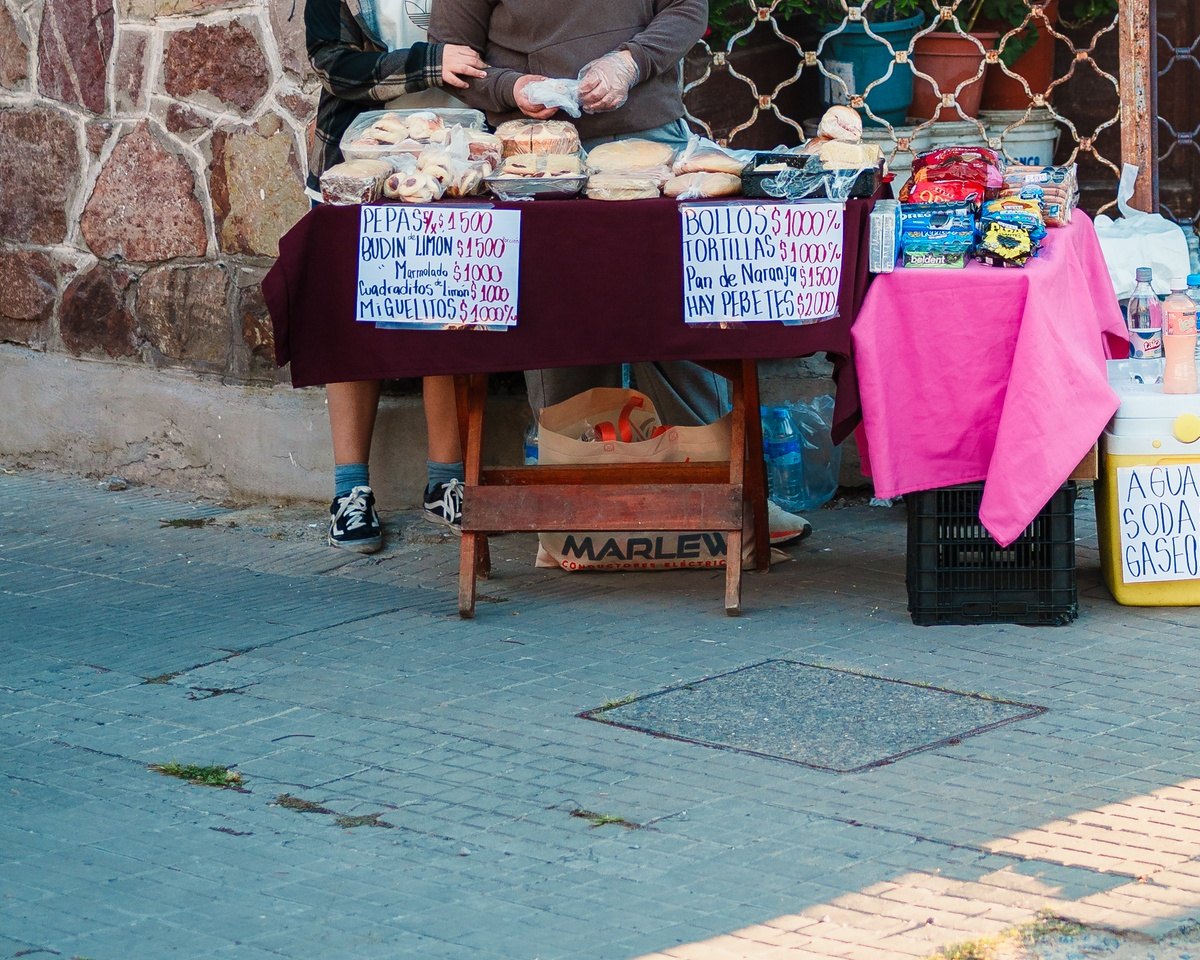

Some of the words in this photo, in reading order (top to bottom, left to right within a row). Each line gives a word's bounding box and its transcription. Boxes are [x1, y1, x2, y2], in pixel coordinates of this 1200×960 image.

[363, 207, 423, 234] PEPAS
[685, 205, 768, 236] BOLLOS
[361, 236, 406, 261] BUDIN
[456, 237, 506, 259] $1500
[683, 234, 775, 263] TORTILLAS
[453, 261, 503, 283] $1000
[686, 265, 713, 291] Pan
[719, 264, 738, 287] de
[741, 263, 797, 287] Naranja
[800, 266, 839, 289] $1500
[358, 279, 434, 297] Cuadraditos
[470, 281, 510, 303] $1000
[686, 294, 715, 318] HAY
[721, 289, 795, 319] PEBETES
[797, 291, 836, 317] $2000
[1127, 465, 1199, 502] AGUA
[1123, 499, 1196, 539] SODA
[561, 532, 727, 561] MARLEW
